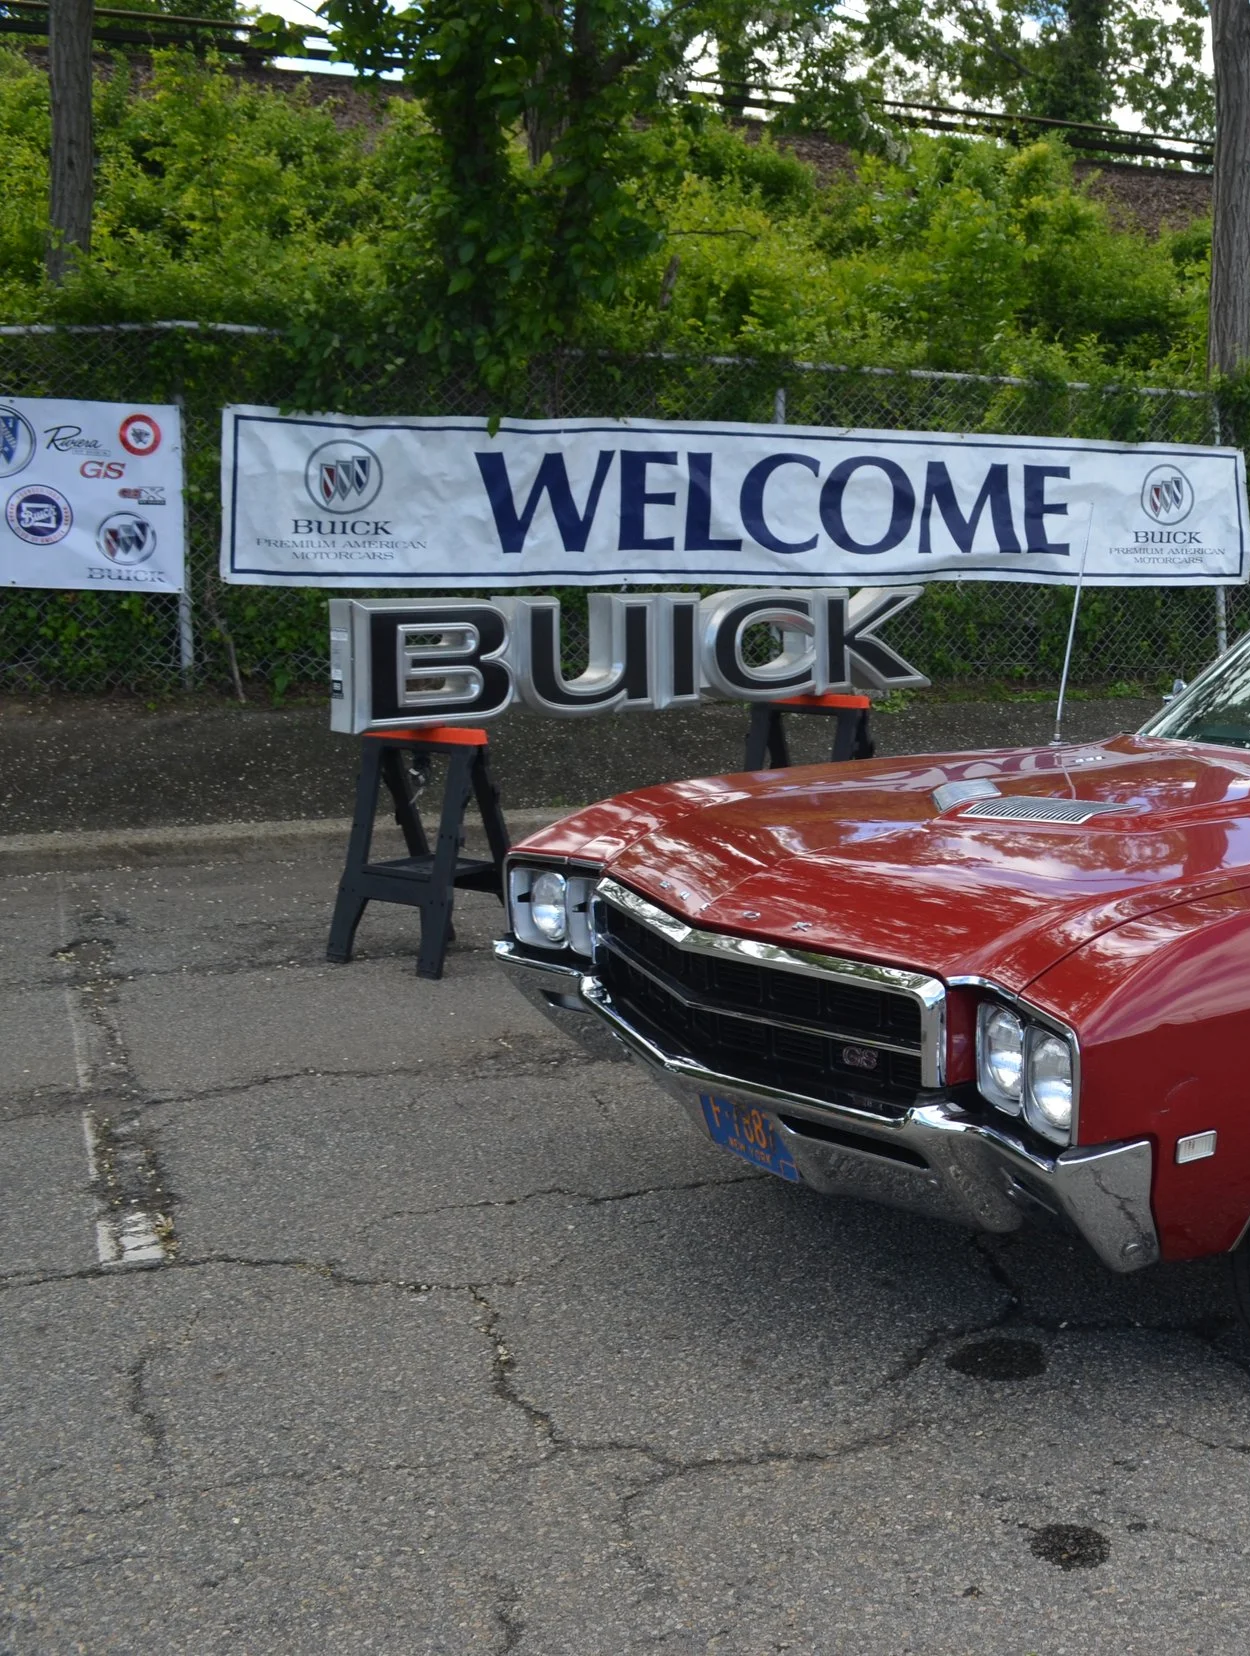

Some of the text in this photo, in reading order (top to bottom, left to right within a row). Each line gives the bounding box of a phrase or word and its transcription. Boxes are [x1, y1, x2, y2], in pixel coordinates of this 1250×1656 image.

[43, 425, 102, 452] Riviera
[80, 460, 126, 480] GS
[473, 449, 1070, 557] WELCOME
[291, 518, 393, 536] BUICK
[256, 537, 428, 550] PREMIUM AMERICAN
[1132, 530, 1203, 544] BUICK
[291, 551, 394, 561] MOTORCARS
[1109, 547, 1226, 556] PREMIUM AMERICAN
[1133, 556, 1204, 565] MOTORCARS
[87, 567, 166, 583] BUICK
[350, 586, 932, 733] BUICK
[842, 1045, 879, 1070] GS
[728, 1135, 772, 1166] NEW YORK
